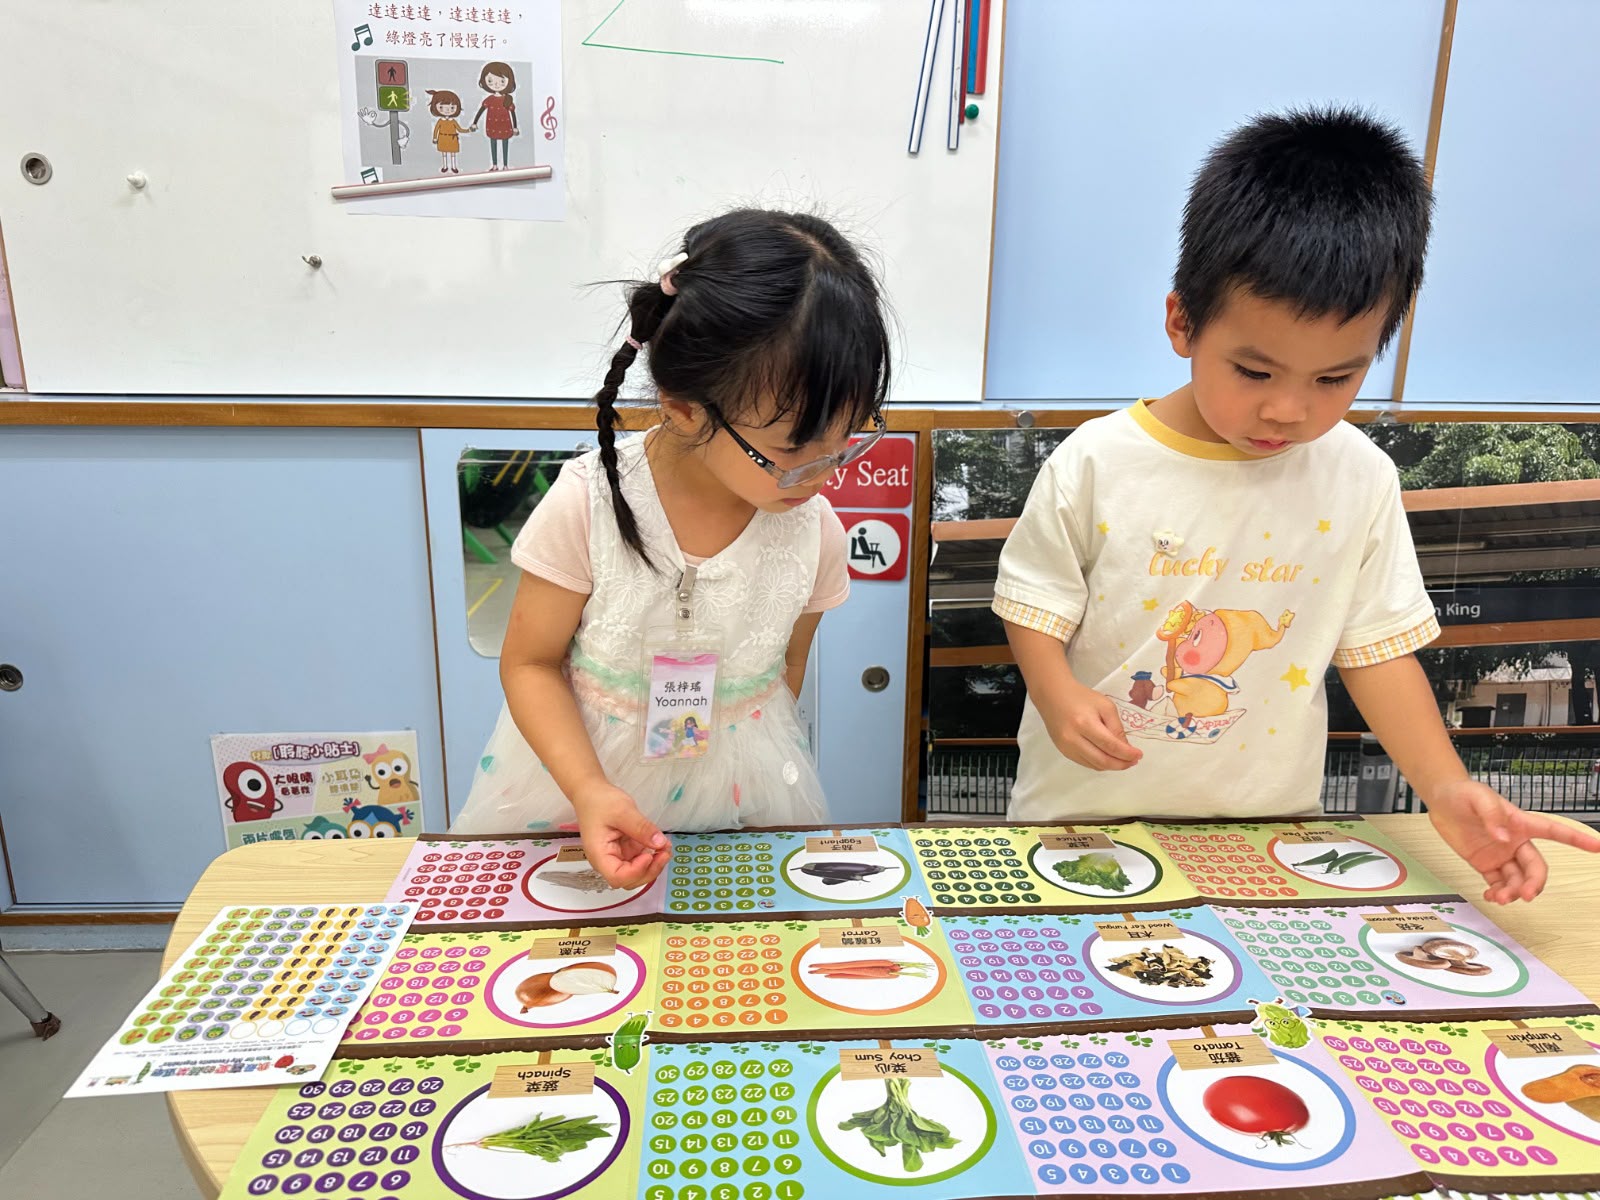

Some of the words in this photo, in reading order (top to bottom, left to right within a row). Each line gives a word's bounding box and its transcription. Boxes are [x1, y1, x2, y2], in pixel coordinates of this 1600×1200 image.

[386, 30, 508, 49] 綠燈亮了慢慢行。
[857, 460, 909, 486] Seat
[1241, 556, 1304, 583] star
[1446, 603, 1480, 622] King
[656, 696, 708, 707] Yoannah
[1506, 1032, 1562, 1042] Pumpkin
[1194, 1042, 1244, 1052] Tomato
[1327, 1039, 1345, 1048] 30
[1354, 1041, 1371, 1049] 29
[1378, 1042, 1396, 1050] 28
[1407, 1043, 1422, 1051] 27
[1526, 1043, 1563, 1053] 南瓜
[890, 1052, 921, 1061] Choy
[1108, 1056, 1126, 1064] 26
[772, 1064, 789, 1072] 26
[874, 1063, 907, 1074] 菜心
[1343, 1059, 1361, 1068] 25
[1369, 1061, 1388, 1069] 24
[1394, 1062, 1414, 1070] 23
[1448, 1063, 1464, 1071] 21
[518, 1068, 571, 1080] Spinach
[658, 1069, 676, 1079] 30
[687, 1066, 704, 1076] 29
[716, 1065, 732, 1074] 28
[744, 1064, 761, 1074] 27
[525, 1081, 559, 1092] 菠菜
[775, 1086, 789, 1096] 21
[657, 1093, 674, 1102] 25
[687, 1090, 704, 1101] 24
[716, 1089, 733, 1099] 23
[744, 1088, 762, 1098] 22
[1034, 1144, 1052, 1154] 10
[1068, 1144, 1078, 1153] 9
[1098, 1144, 1108, 1153] 8
[1130, 1144, 1138, 1153] 7
[1157, 1143, 1167, 1152] 6
[267, 1154, 284, 1164] 15
[300, 1153, 317, 1163] 14
[332, 1152, 348, 1162] 13
[364, 1151, 380, 1161] 12
[398, 1150, 410, 1160] 11
[1047, 1169, 1056, 1179] 5
[1078, 1169, 1087, 1179] 4
[1109, 1169, 1119, 1179] 3
[1139, 1168, 1150, 1179] 2
[1171, 1168, 1180, 1178] 1
[254, 1179, 272, 1190] 10
[290, 1178, 301, 1189] 9
[324, 1177, 336, 1188] 8
[356, 1176, 368, 1187] 7
[392, 1175, 401, 1185] 6
